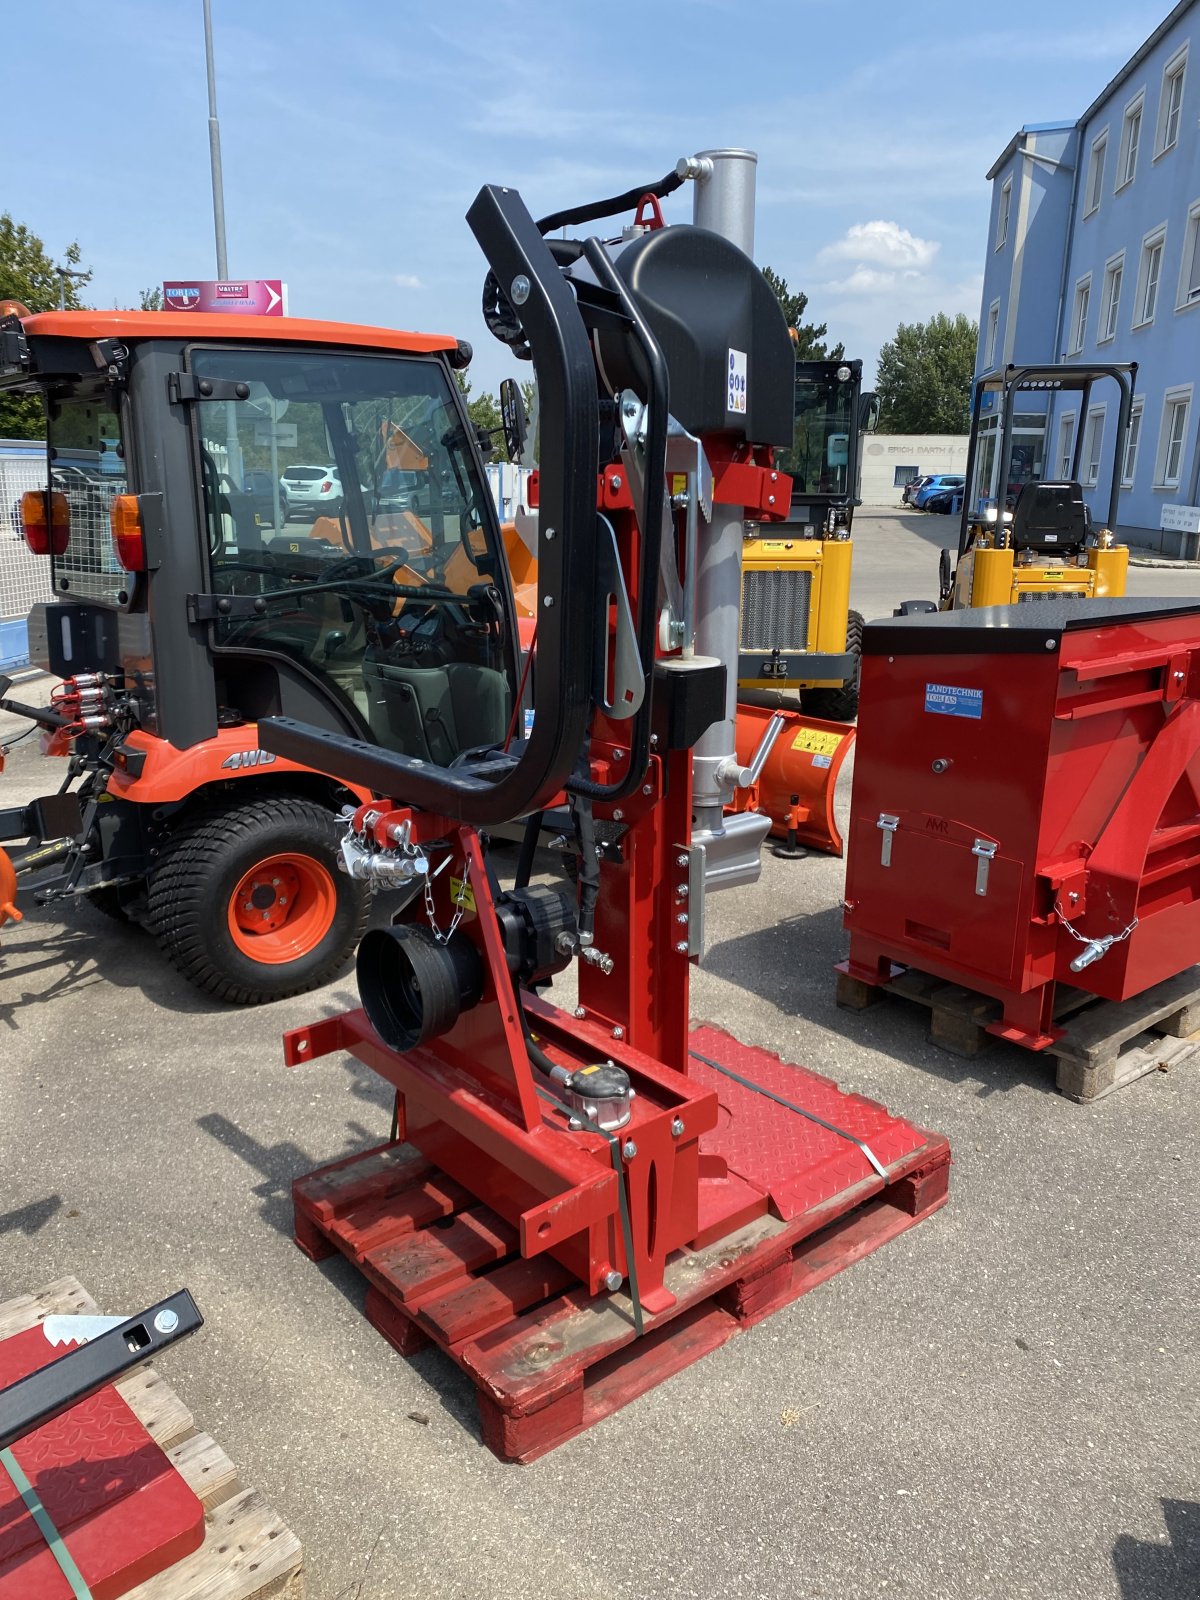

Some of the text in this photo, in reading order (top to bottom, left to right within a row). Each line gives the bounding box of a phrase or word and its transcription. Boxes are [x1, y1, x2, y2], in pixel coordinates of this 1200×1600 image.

[166, 288, 200, 297] TOBIAS
[887, 446, 914, 454] ERICH
[927, 684, 982, 698] LANDTECHNIK
[928, 694, 957, 704] TOBIAS
[221, 749, 276, 770] 4WD
